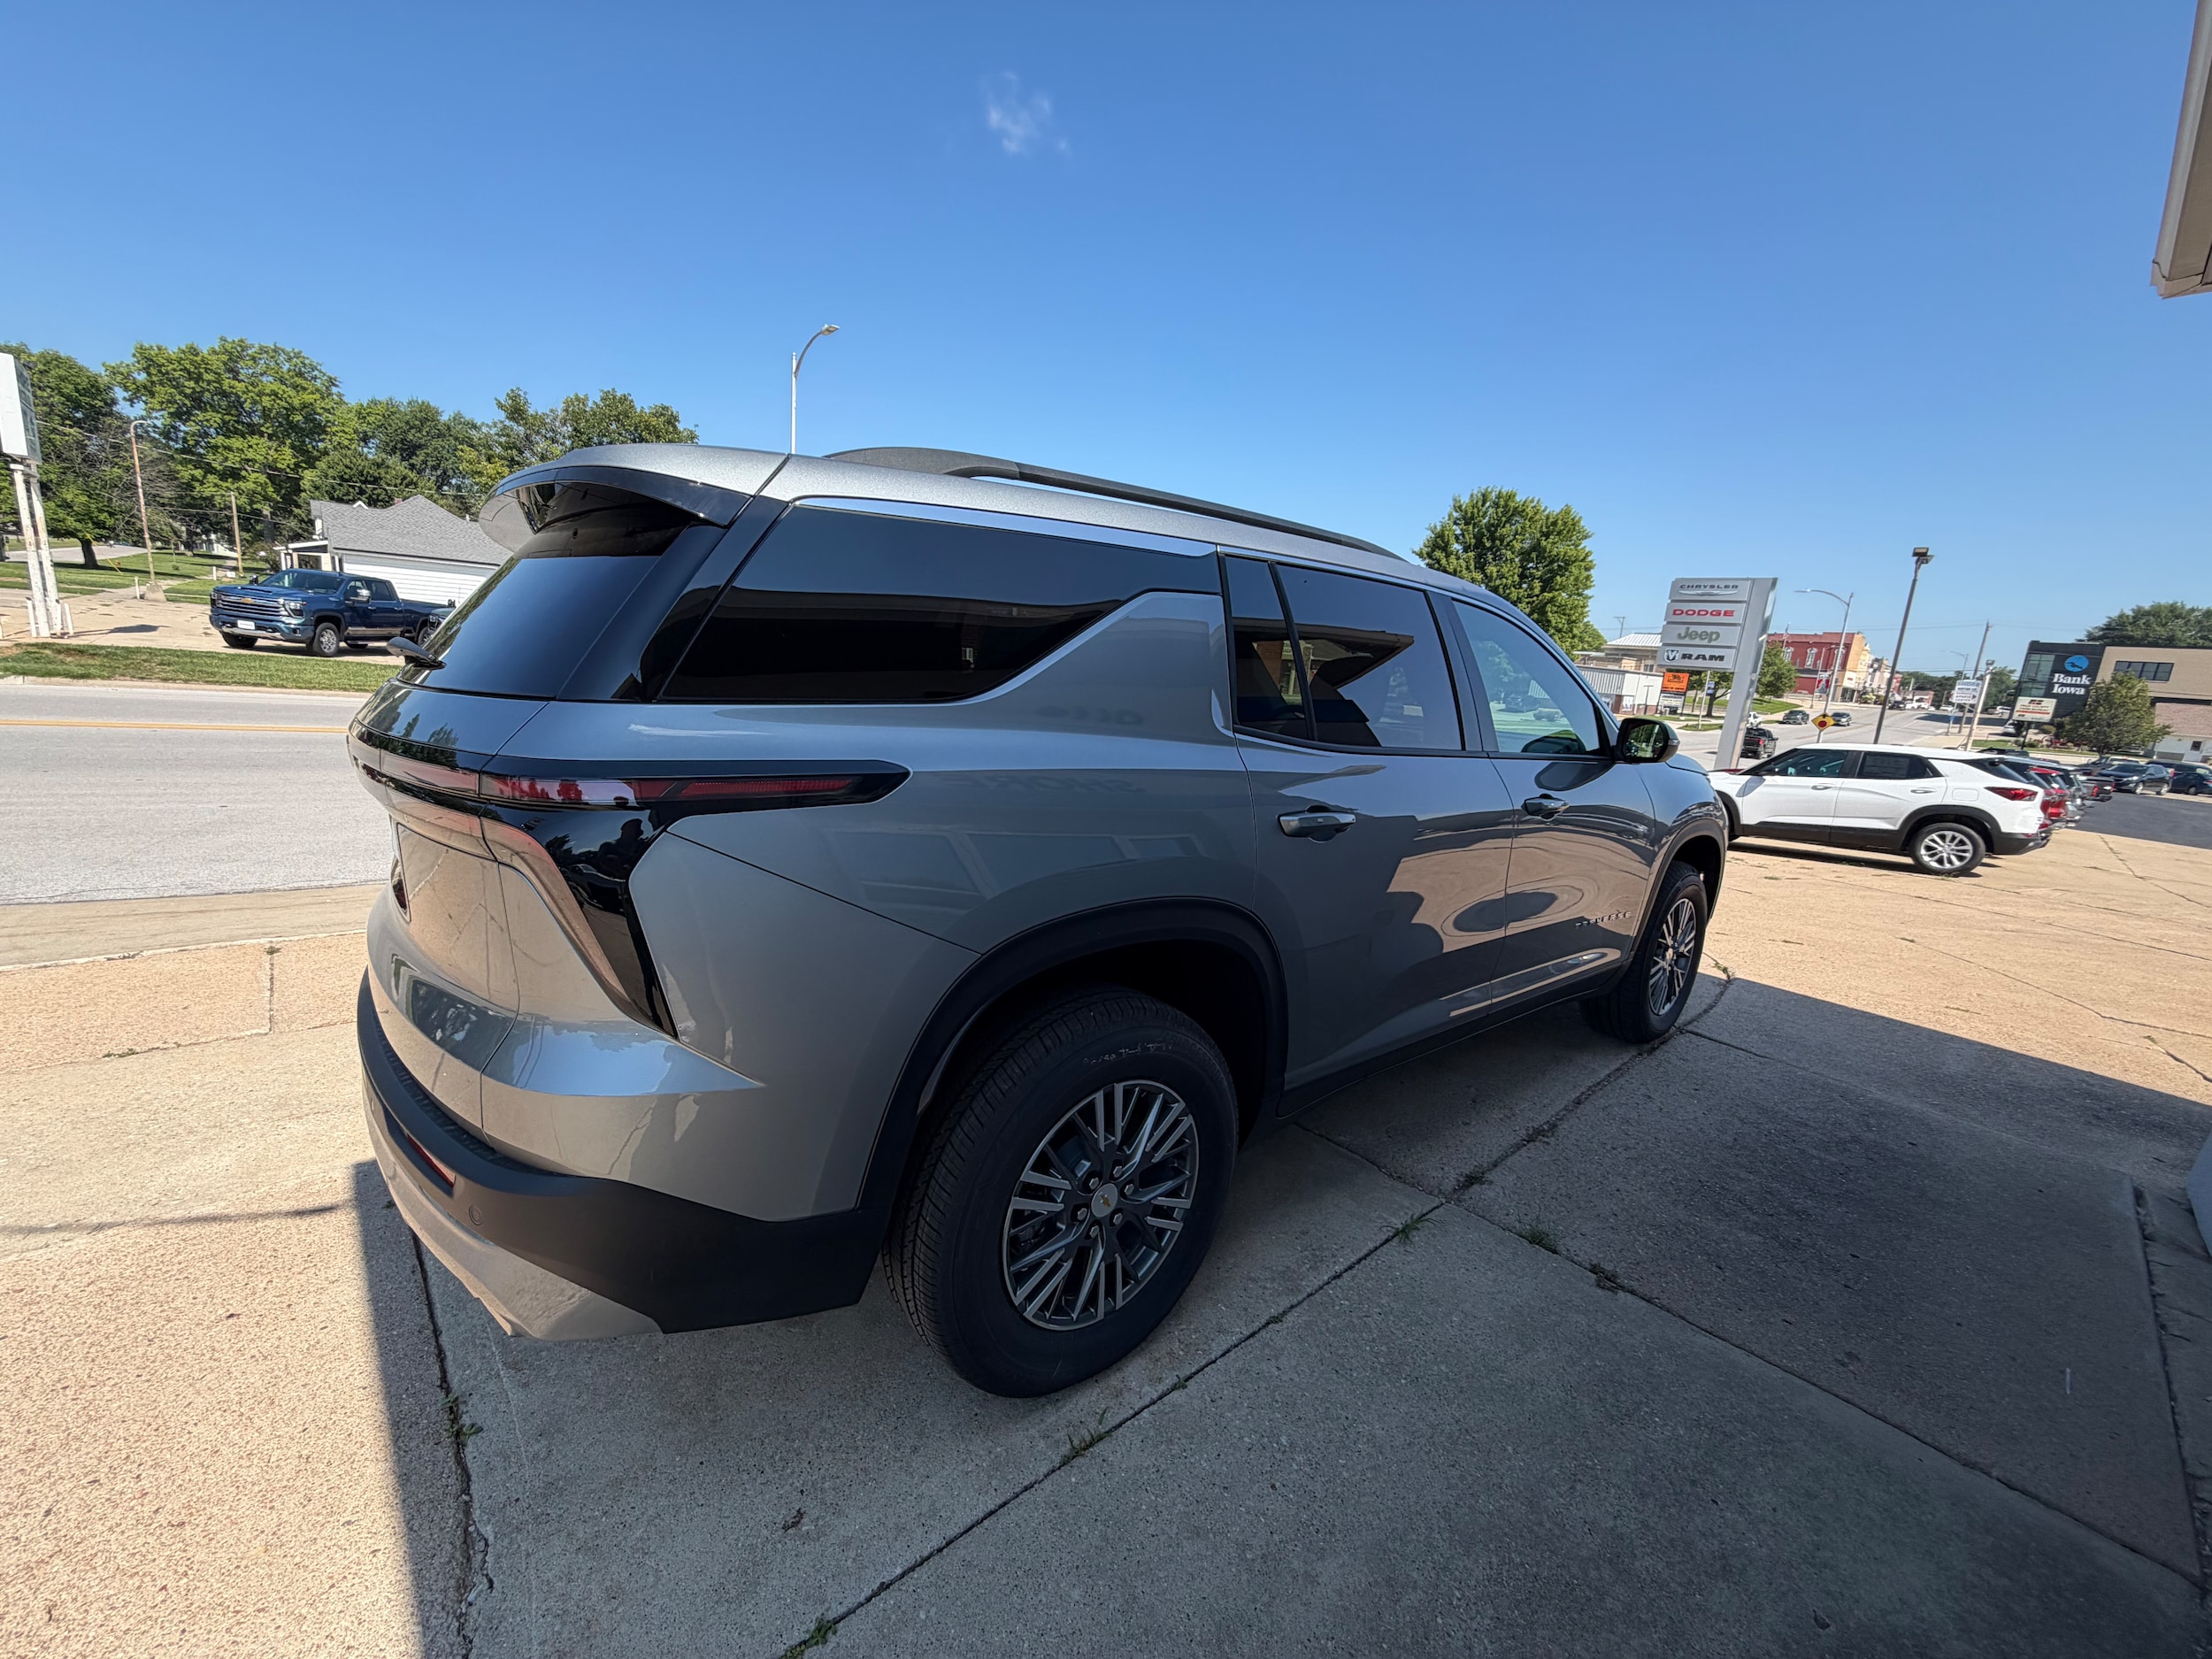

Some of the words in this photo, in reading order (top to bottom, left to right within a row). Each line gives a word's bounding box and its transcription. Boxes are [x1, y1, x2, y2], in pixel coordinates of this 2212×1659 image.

[1678, 626, 1720, 643] Jeep
[1681, 653, 1725, 662] RAM
[2053, 673, 2091, 685] Bank
[2051, 684, 2085, 695] Iowa
